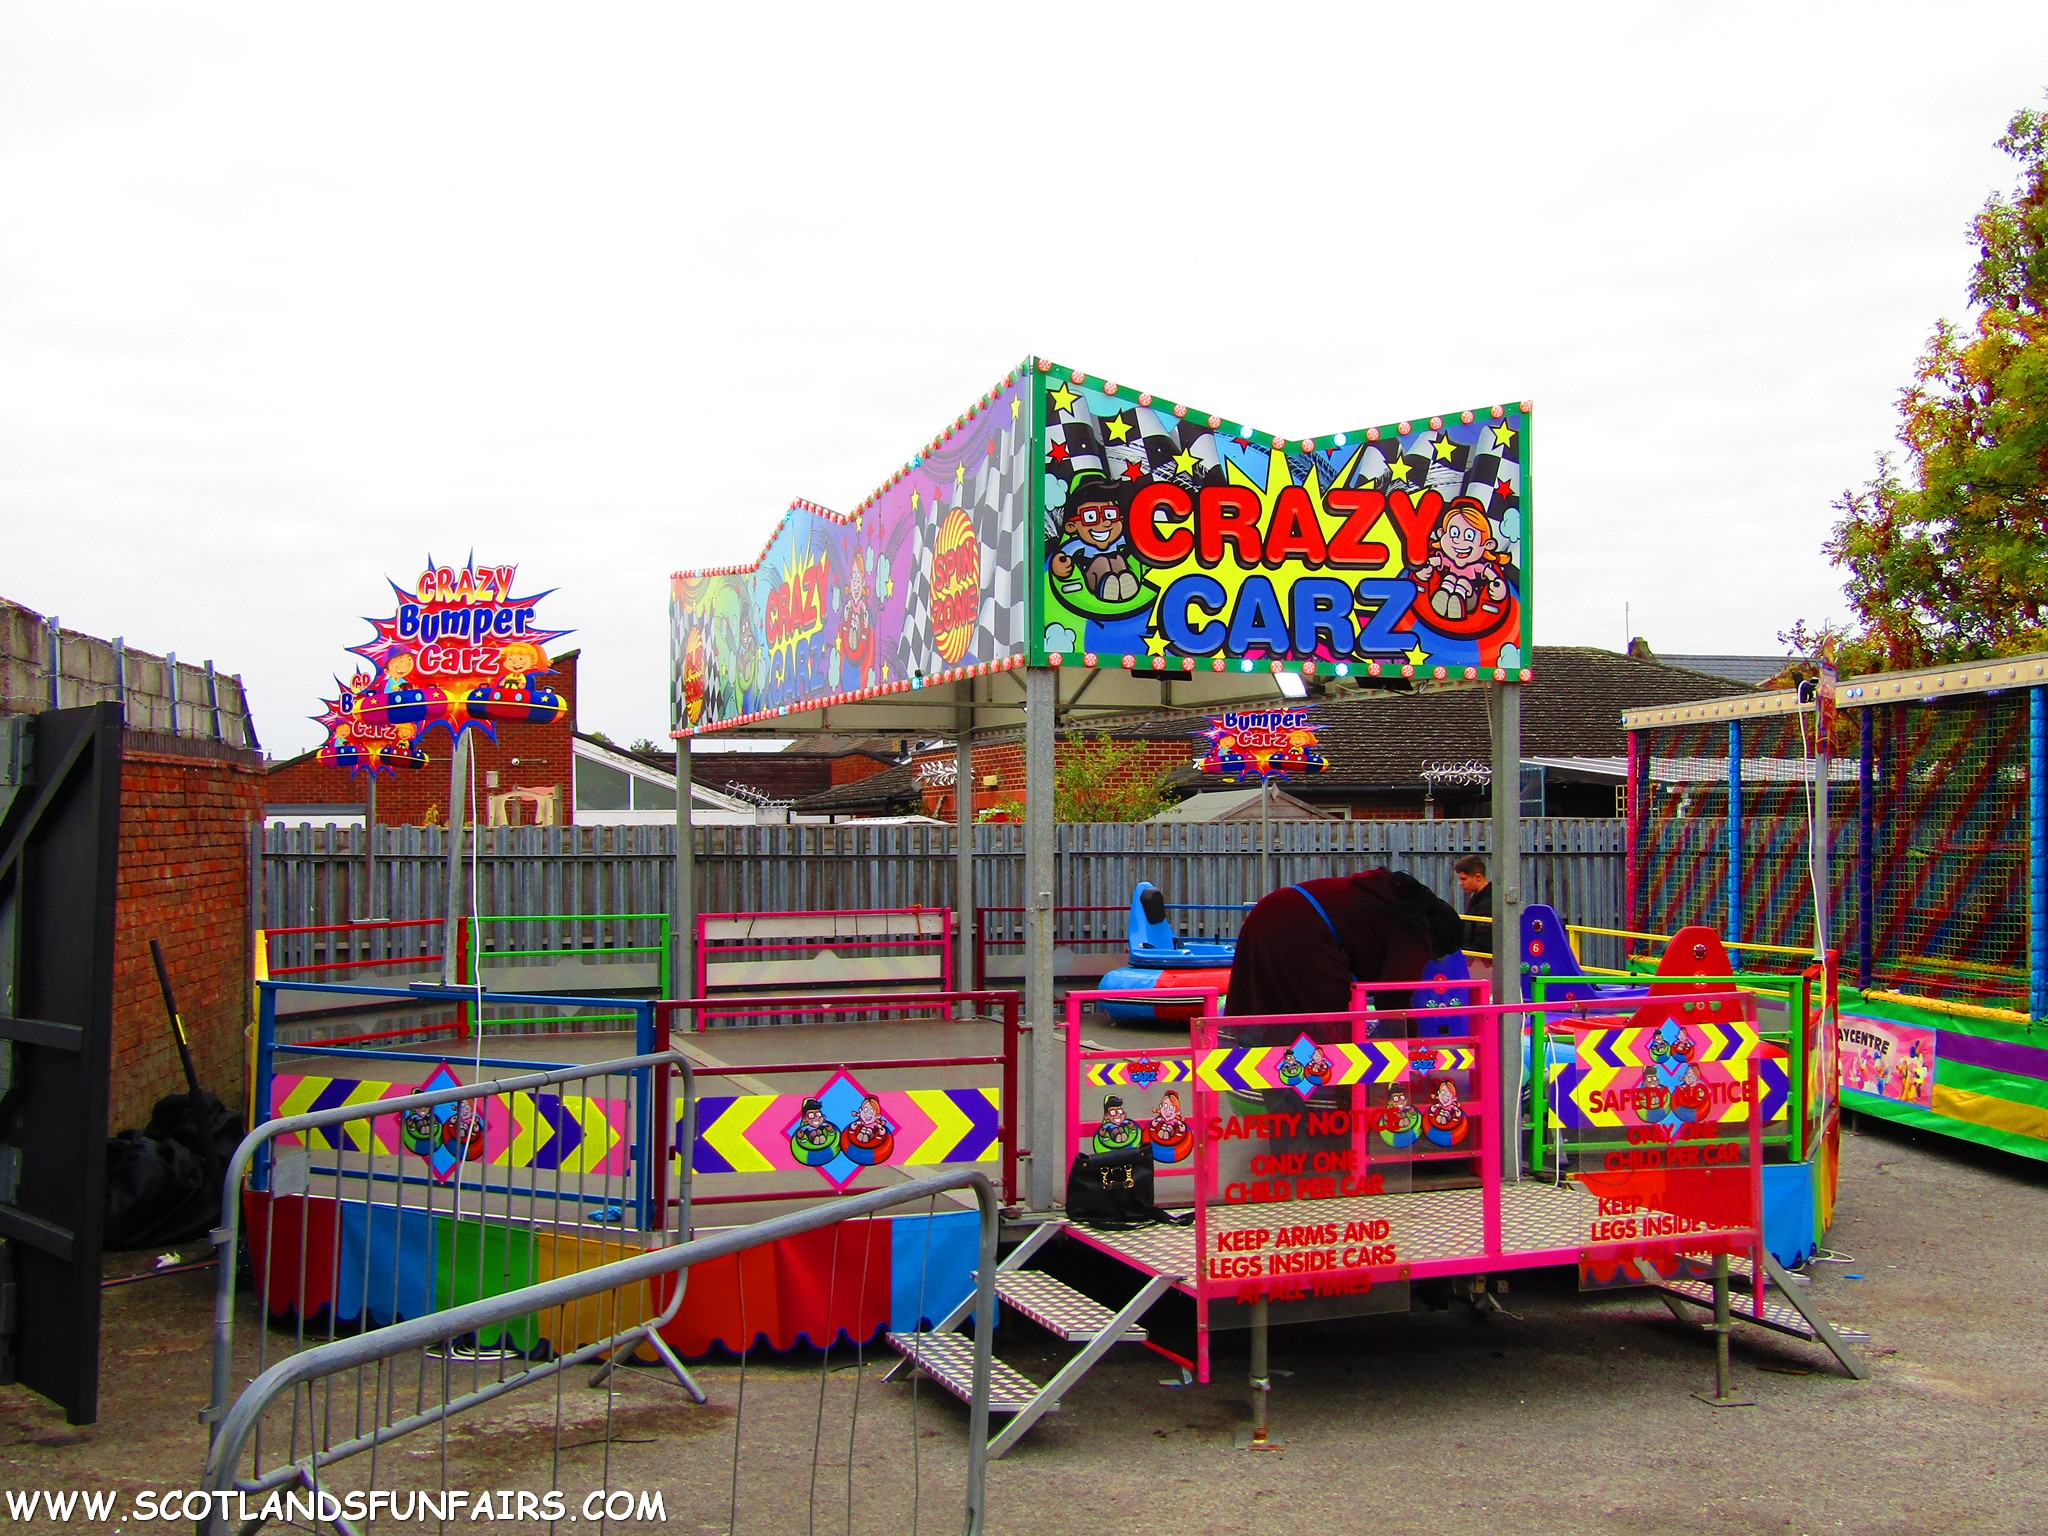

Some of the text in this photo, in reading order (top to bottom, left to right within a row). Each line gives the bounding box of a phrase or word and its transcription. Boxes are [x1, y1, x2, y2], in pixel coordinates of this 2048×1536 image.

[1127, 482, 1446, 571] CRAZY
[934, 536, 977, 592] SPIN
[415, 565, 516, 605] CRAZY
[765, 558, 832, 649] CRAZY
[932, 590, 979, 636] ZONE
[1158, 575, 1420, 657] CARZ
[397, 603, 536, 645] Bumper
[416, 643, 501, 675] Carz
[770, 634, 825, 706] CARZ
[1223, 711, 1308, 732] Bumper
[1236, 730, 1289, 748] Carz
[1533, 944, 1540, 953] 6
[1127, 1062, 1161, 1073] CRAZY
[1130, 1071, 1158, 1082] CARZ
[1411, 1060, 1435, 1070] CARZ
[1589, 1080, 1754, 1113] SAFETY NOTICE
[1207, 1107, 1402, 1141] SAFETY NOTICE
[1627, 1121, 1719, 1145] ONLY ONE
[1251, 1151, 1358, 1176] ONLY ONE
[1604, 1142, 1742, 1172] CHILD PER CAR
[1224, 1174, 1384, 1205] CHILD PER CAR
[1598, 1195, 1642, 1216] KEEP
[1217, 1220, 1390, 1252] KEEP ARMS AND
[1591, 1219, 1637, 1242] LEGS
[1642, 1214, 1701, 1237] INSIDE
[1209, 1244, 1397, 1279] LEGS INSIDE CARS
[1236, 1273, 1373, 1305] AT ALL TIMES
